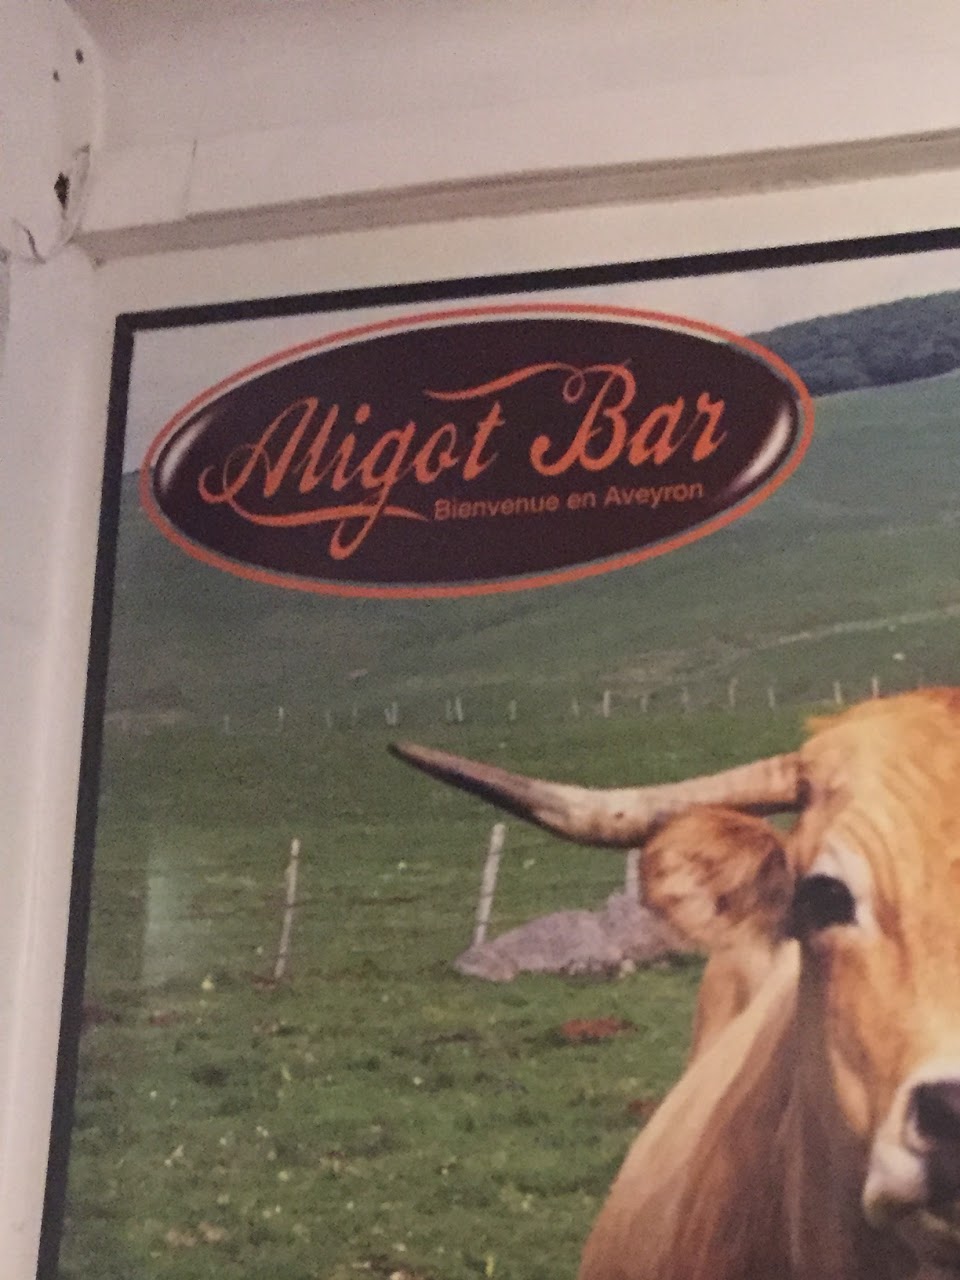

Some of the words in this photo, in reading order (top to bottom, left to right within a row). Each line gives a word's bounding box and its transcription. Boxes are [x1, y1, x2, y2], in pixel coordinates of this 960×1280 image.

[199, 396, 507, 561] Aligot
[424, 359, 729, 477] Bar
[433, 494, 559, 521] Bienvenue
[567, 491, 597, 510] en
[604, 483, 704, 508] Aveyron
